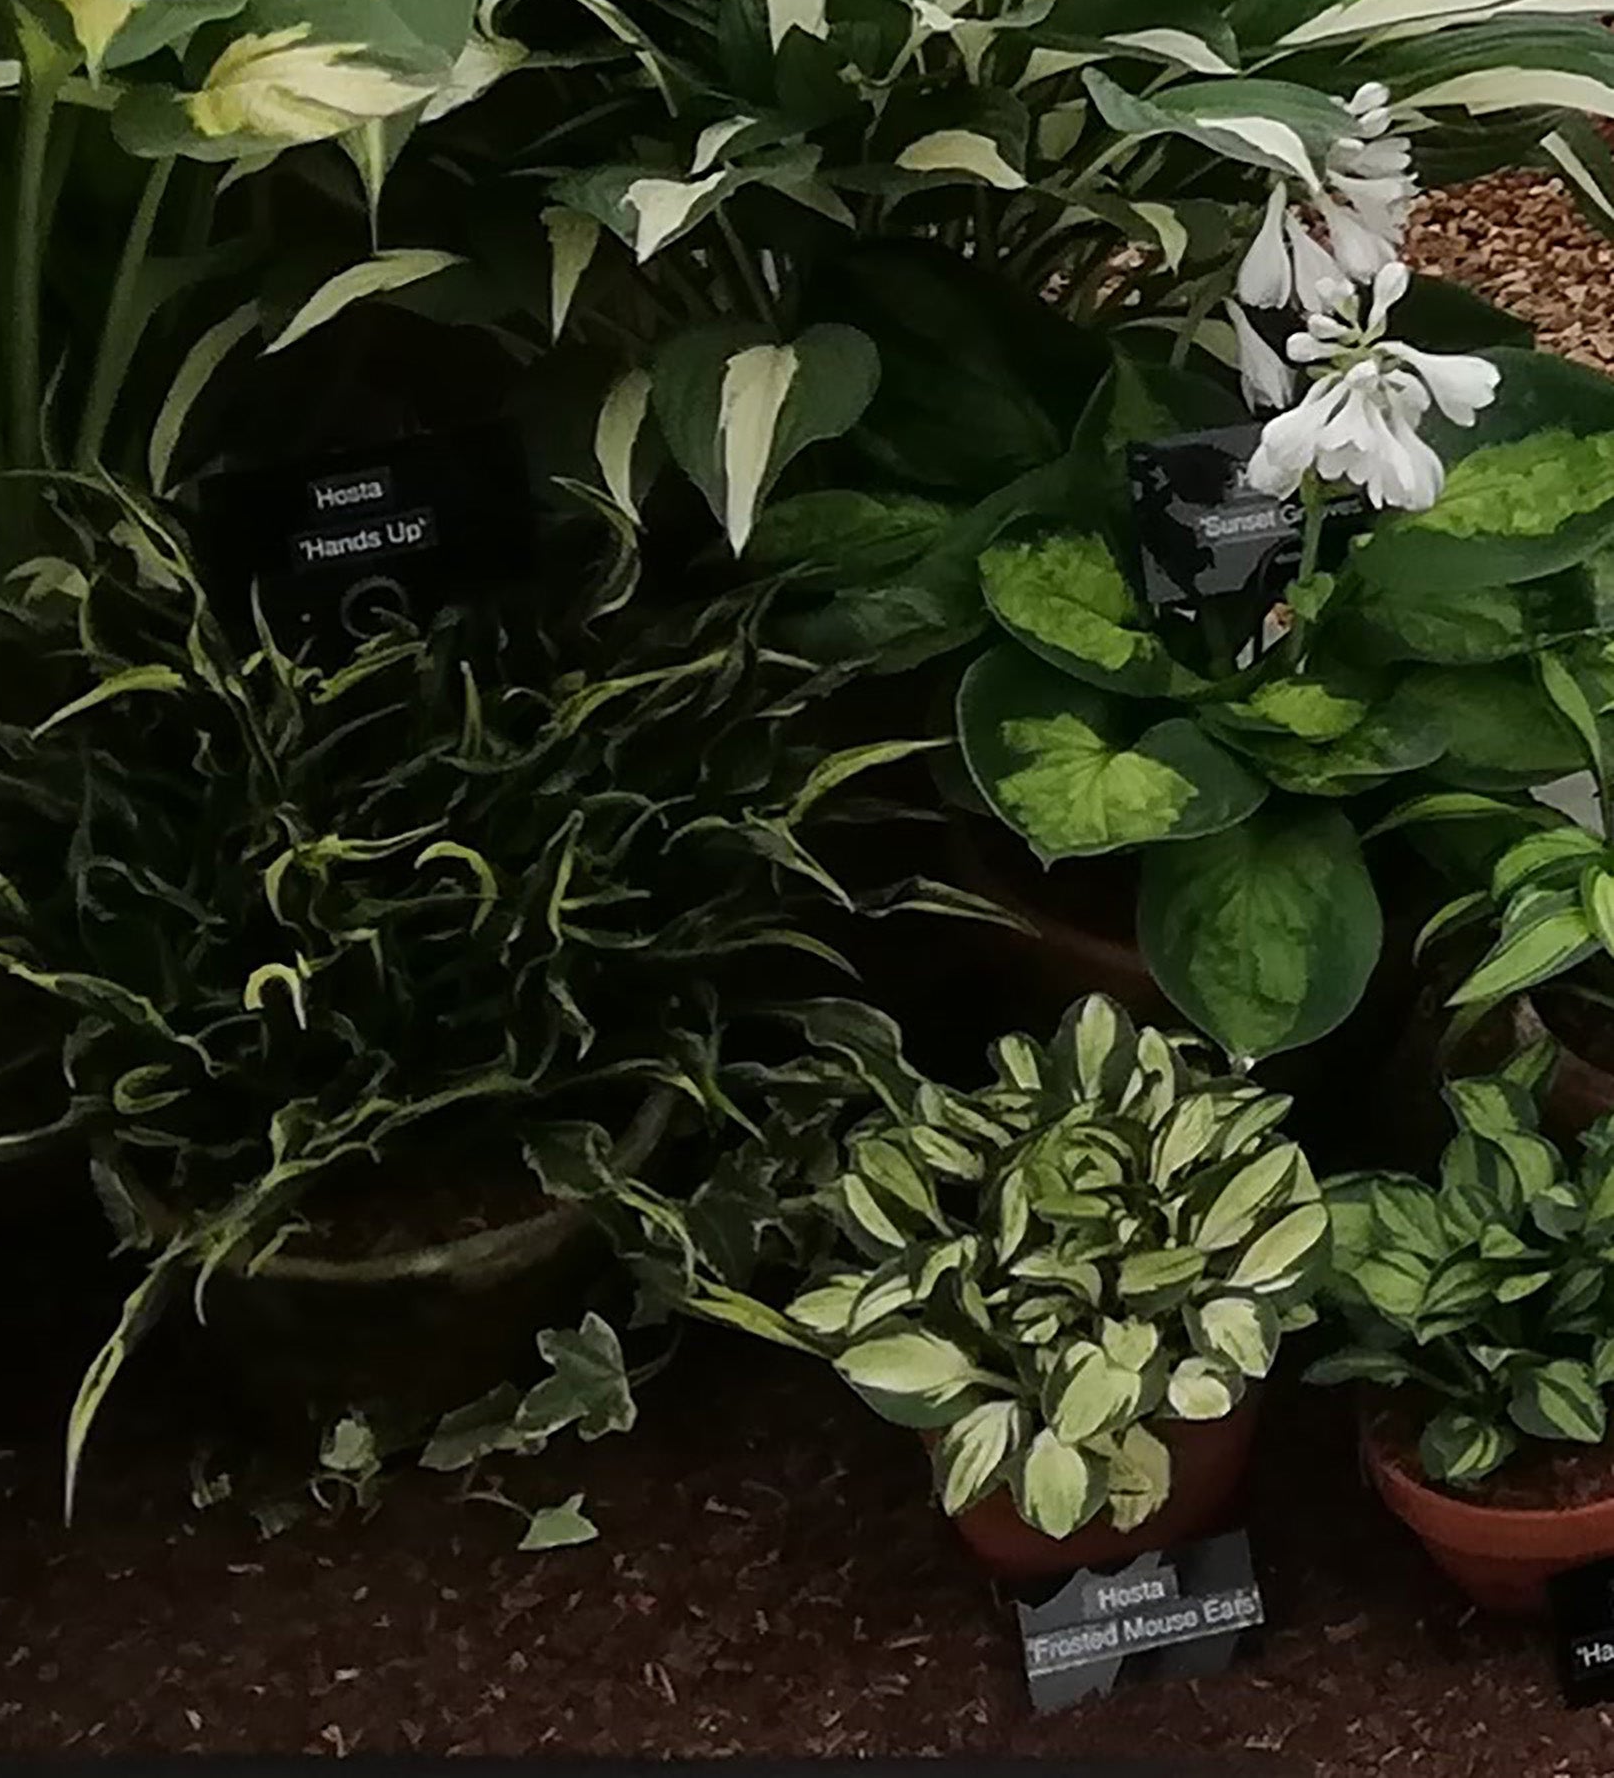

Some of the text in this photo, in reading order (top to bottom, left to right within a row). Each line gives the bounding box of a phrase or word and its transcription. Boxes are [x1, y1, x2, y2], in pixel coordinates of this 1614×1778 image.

[315, 480, 384, 510] Hosta
[299, 516, 428, 561] 'Hands Up'
[1097, 1579, 1167, 1611] Hosta
[1123, 1608, 1198, 1644] Mouse
